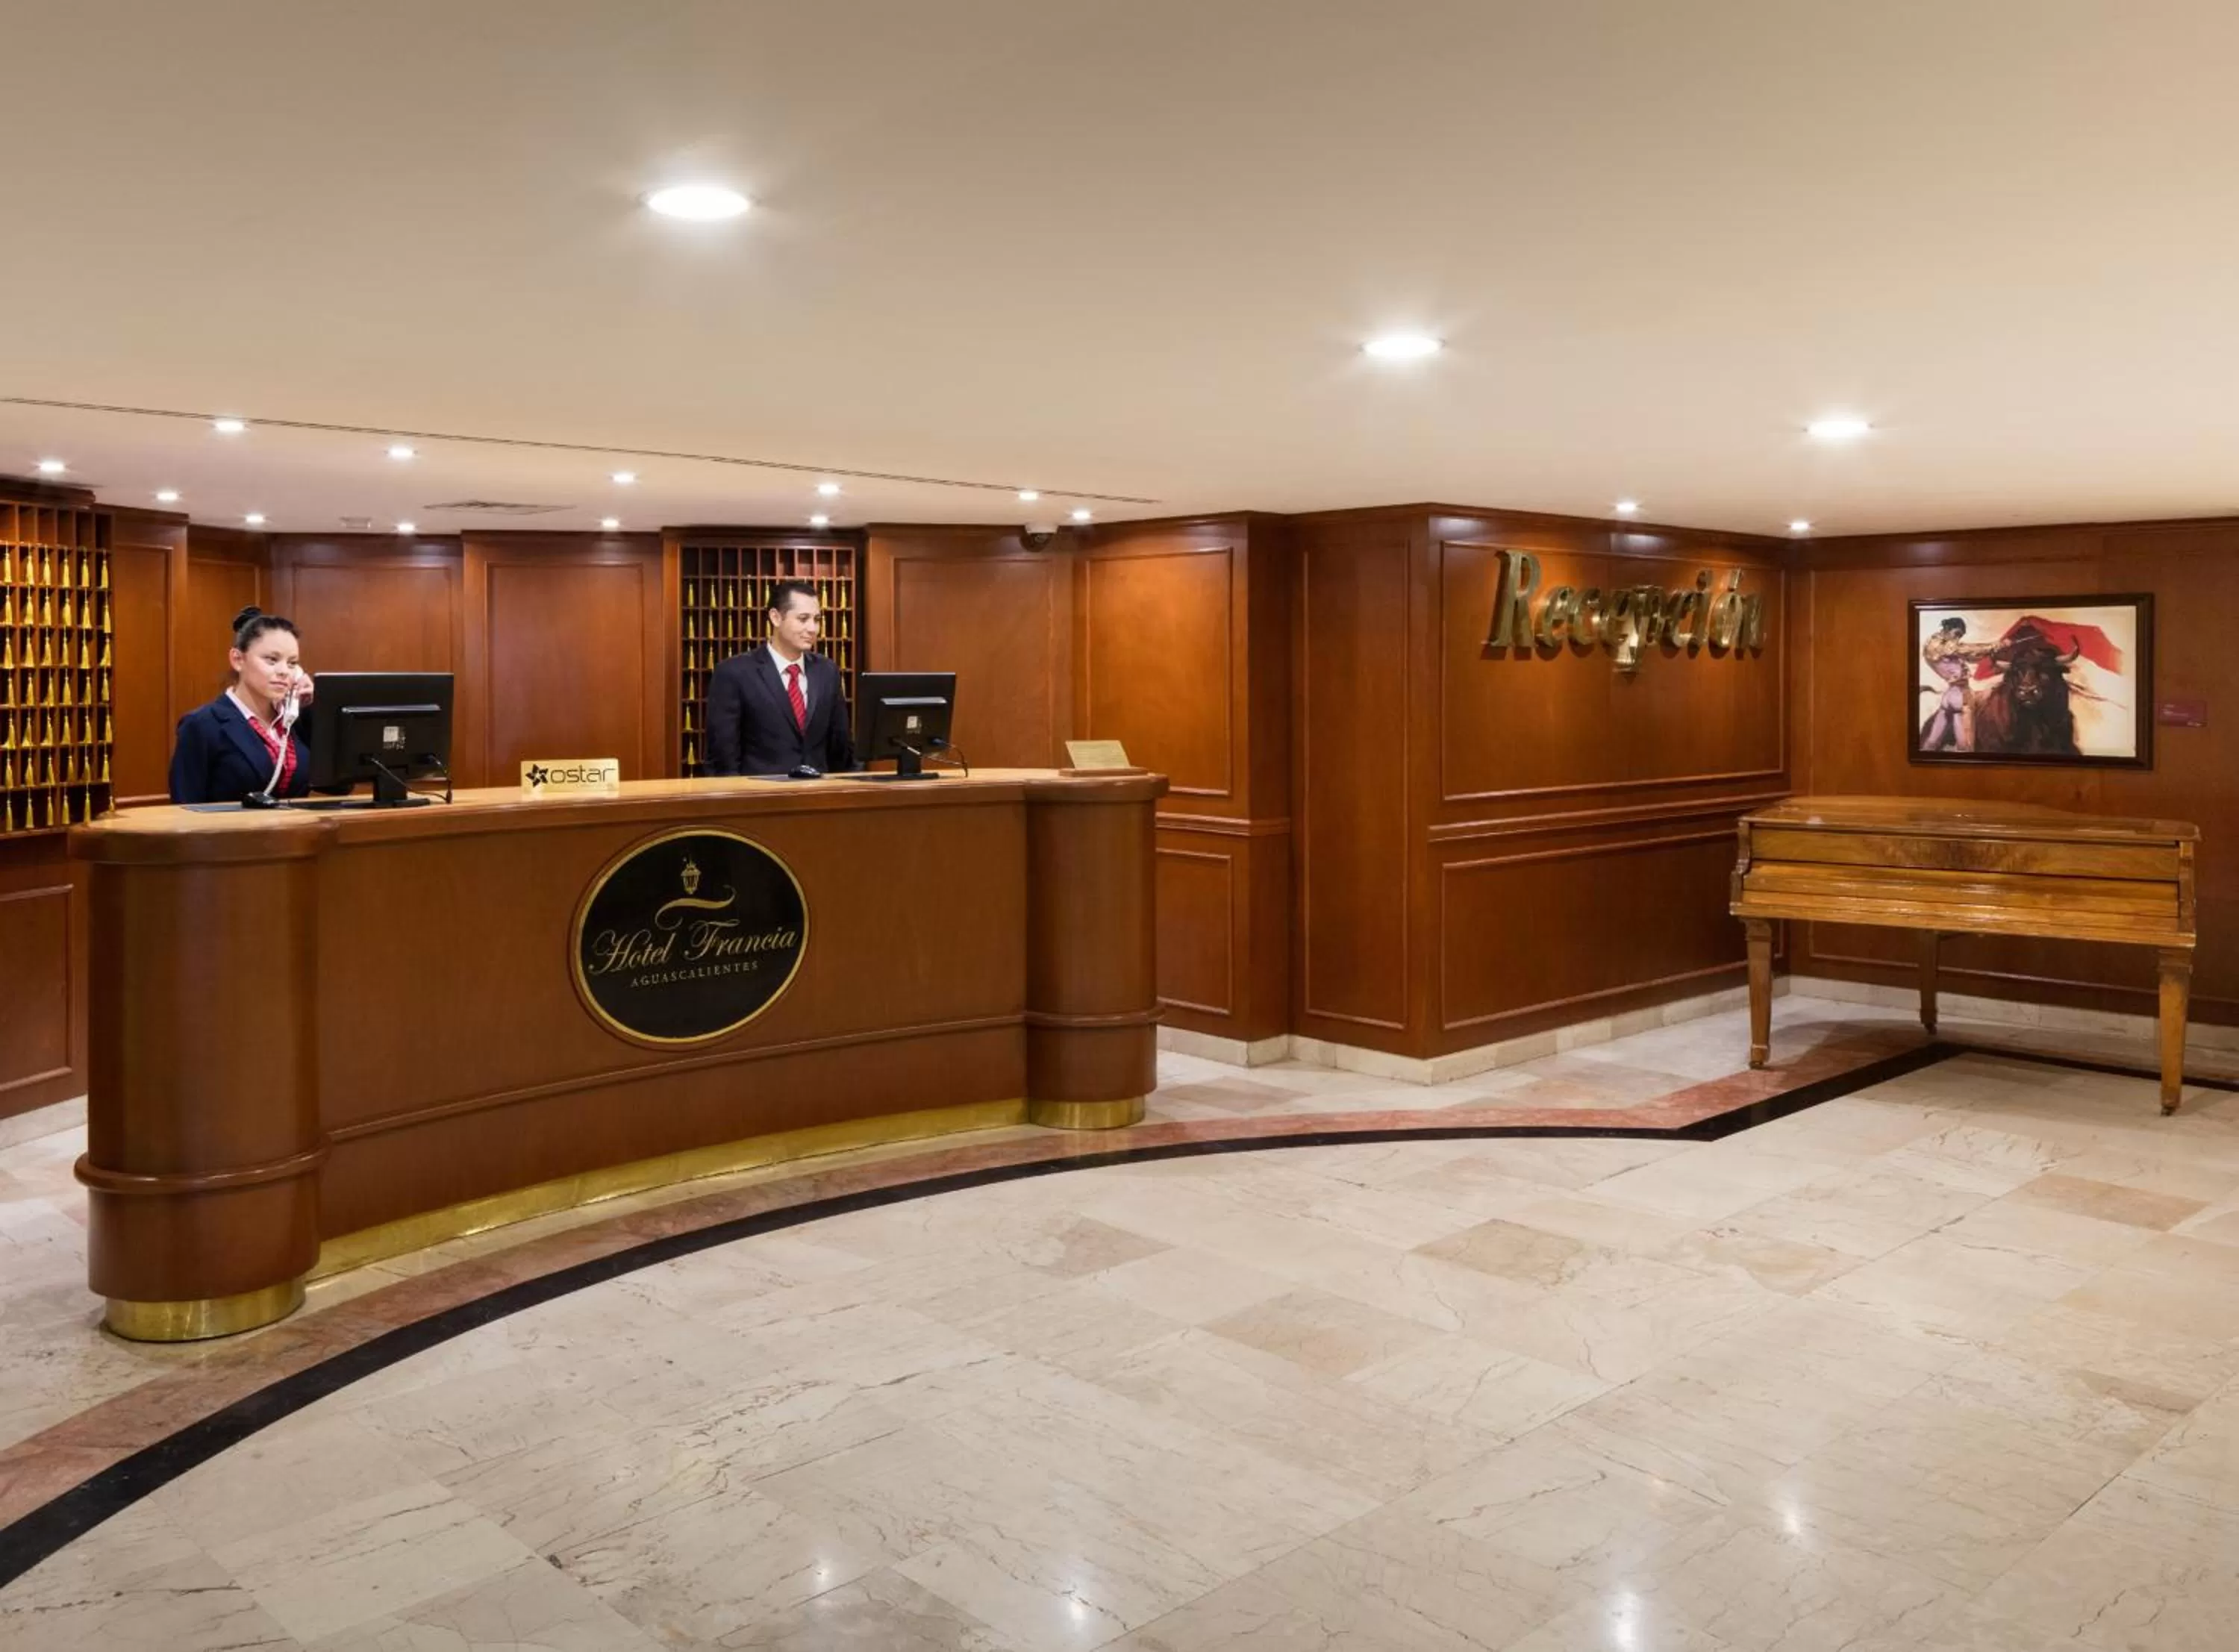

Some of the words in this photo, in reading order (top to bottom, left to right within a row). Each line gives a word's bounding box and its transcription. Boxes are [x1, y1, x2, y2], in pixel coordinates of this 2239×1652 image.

[550, 765, 616, 783] ostar
[588, 929, 675, 974] Hotel
[684, 919, 798, 961] Francia
[630, 960, 759, 988] AGUASCALIENTES
